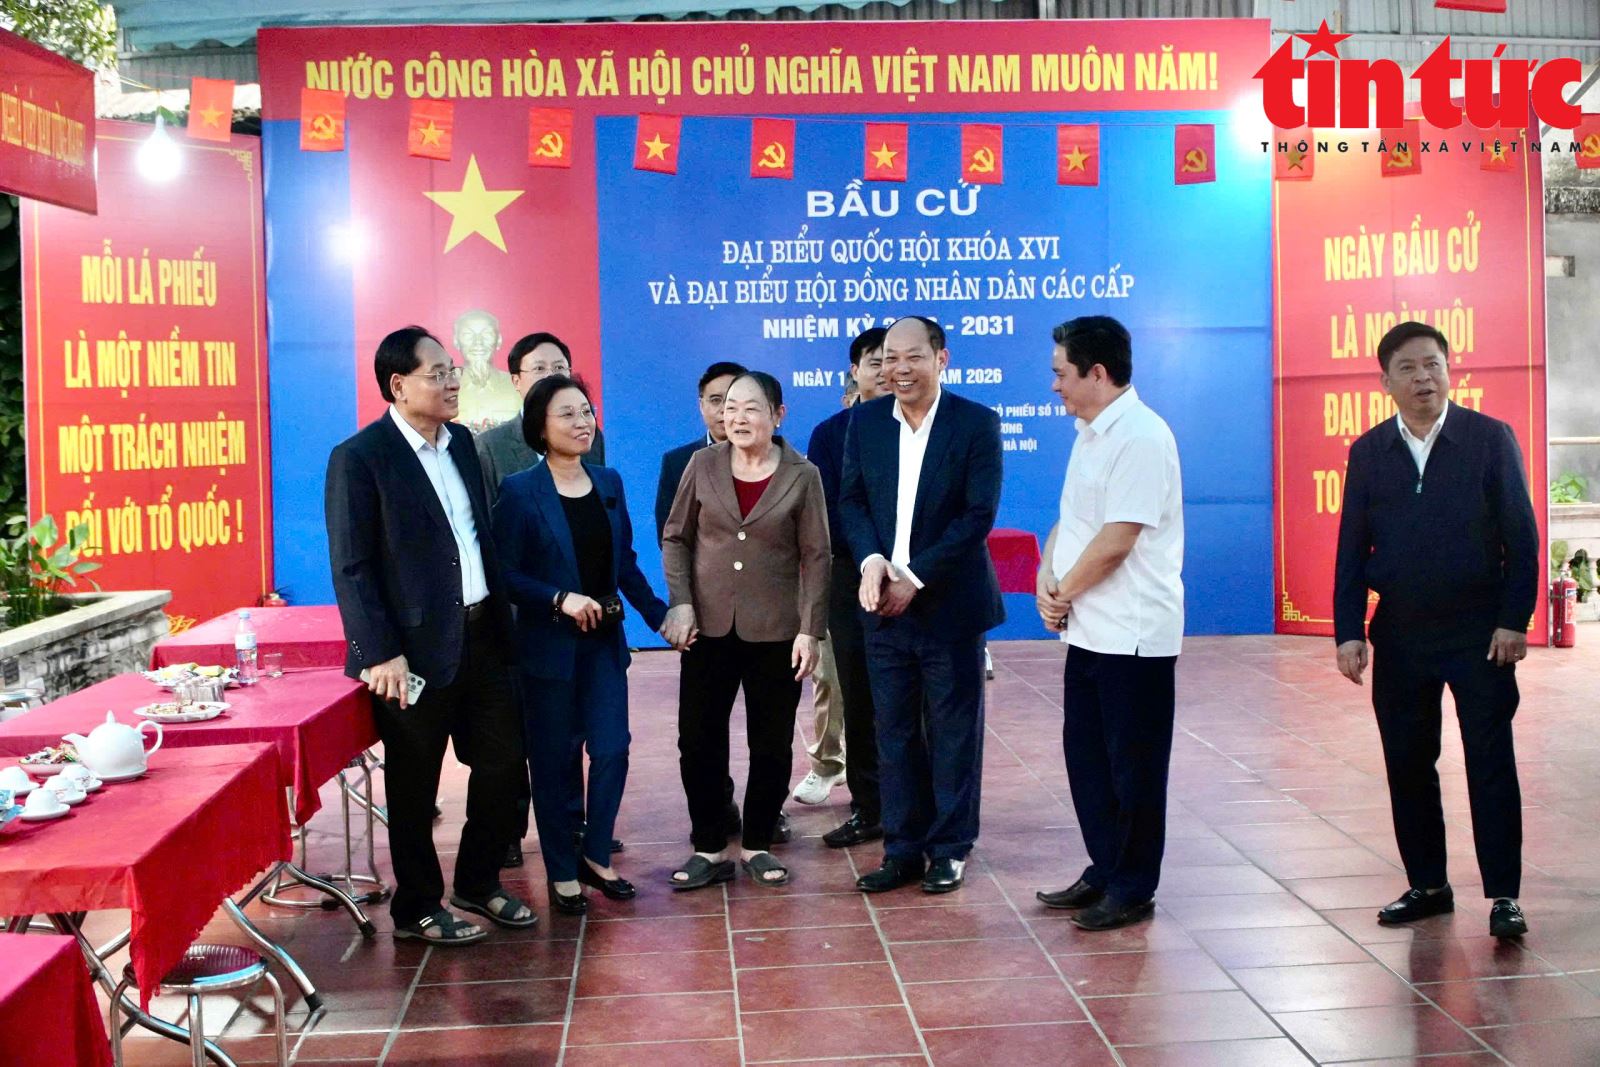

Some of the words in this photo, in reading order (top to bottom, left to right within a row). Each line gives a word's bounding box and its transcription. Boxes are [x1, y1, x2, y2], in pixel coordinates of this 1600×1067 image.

[306, 52, 394, 99] NƯỚC
[404, 51, 492, 98] CÔNG
[503, 49, 567, 96] HÒA
[576, 50, 619, 96] XÃ
[629, 50, 681, 104] HỘI
[692, 43, 755, 95] CHỦ
[765, 48, 862, 94] NGHĨA
[872, 47, 937, 102] VIỆT
[948, 55, 1020, 93] NAM
[1031, 46, 1124, 93] MUÔN
[1135, 45, 1218, 91] NĂM!
[807, 179, 899, 217] BẦU
[723, 240, 764, 270] ĐẠI
[770, 225, 824, 263] BIỂU
[830, 228, 894, 265] QUỐC
[899, 230, 940, 268] HỘI
[947, 230, 1012, 261] KHÓA
[1018, 237, 1060, 259] XVI
[1325, 225, 1386, 281] NGÀY
[1392, 214, 1439, 277] BẦU
[1446, 210, 1481, 274] CỬ
[81, 239, 123, 304] MỖI
[128, 248, 154, 304] LÁ
[158, 246, 217, 307] PHIẾU
[648, 274, 681, 304] VÀ
[687, 281, 728, 310] ĐẠI
[735, 264, 788, 304] BIỂU
[795, 271, 837, 308] HỘI
[843, 266, 909, 302] ĐỒNG
[914, 269, 981, 301] NHÂN
[987, 269, 1036, 300] DÂN
[1042, 268, 1086, 299] CÁC
[1091, 262, 1135, 298] CẤP
[763, 315, 839, 342] NHIỆM
[846, 313, 875, 338] KỲ
[961, 315, 1014, 336] 2031
[1330, 304, 1358, 359] LÀ
[1434, 298, 1474, 364] HỘI
[64, 330, 92, 388] LÀ
[96, 330, 142, 398] MỘT
[147, 325, 200, 387] NIỀM
[204, 342, 237, 386] TIN
[793, 368, 833, 387] NGÀY
[966, 368, 1003, 385] 2026
[1006, 402, 1036, 417] PHIẾU
[1037, 402, 1052, 417] SỐ
[1324, 392, 1362, 446] ĐẠI
[58, 414, 105, 484] MỘT
[110, 413, 177, 471] TRÁCH
[182, 411, 247, 476] NHIỆM
[1003, 438, 1017, 451] HÀ
[1020, 438, 1038, 453] NỘI
[107, 496, 143, 555] VỚI
[147, 484, 173, 551] TỔ
[178, 484, 230, 553] QUỐC
[236, 499, 244, 543] !
